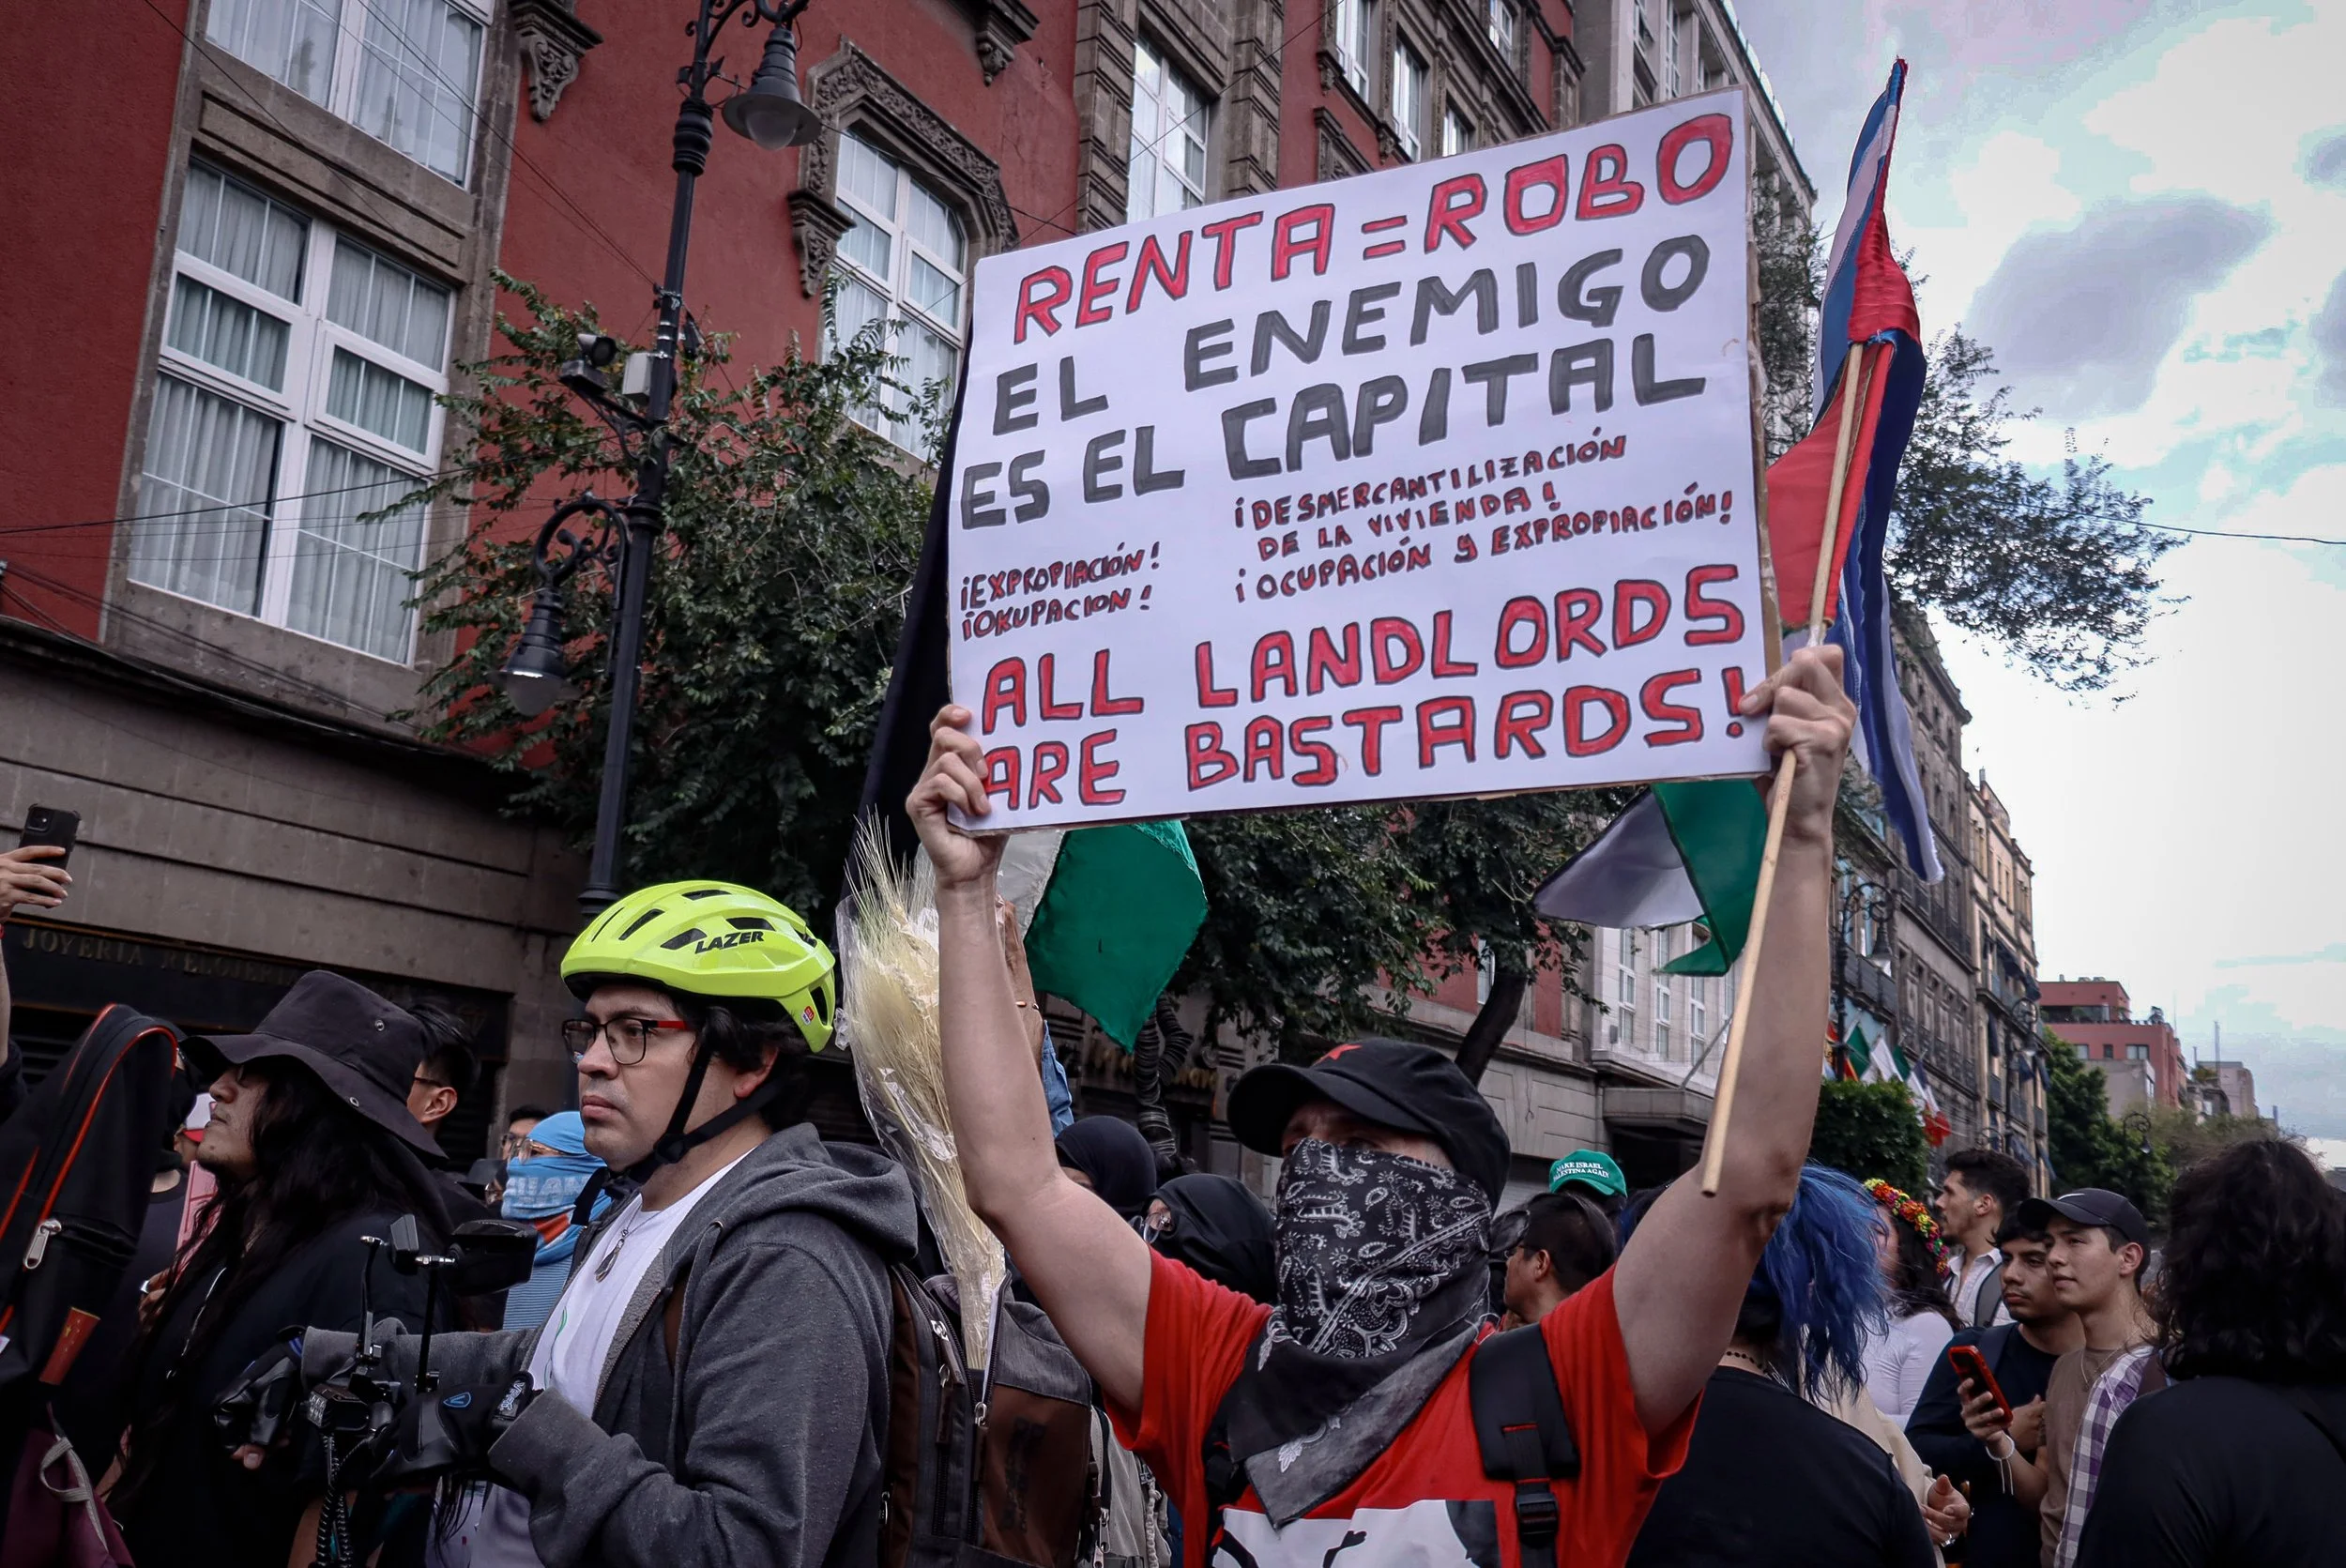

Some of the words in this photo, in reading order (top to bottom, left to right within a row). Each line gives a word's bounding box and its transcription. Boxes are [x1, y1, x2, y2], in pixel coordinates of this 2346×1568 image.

[993, 356, 1109, 435] EL
[1184, 235, 1710, 391] ENEMIGO
[961, 449, 1050, 529] ES
[1083, 425, 1185, 504] EL
[1222, 333, 1706, 480] CAPITAL
[1235, 427, 1627, 530] ¡DESMERCANTILIZACIÓN
[1257, 531, 1300, 561] DE
[1318, 525, 1352, 548] LA
[1491, 481, 1733, 556] EXPROPIACIÓN!
[960, 541, 1161, 611] ¡EXPROPIACIÓN!
[982, 648, 1144, 736] ALL
[1195, 564, 1744, 708] LANDLORDS
[982, 729, 1127, 811] ARE
[1185, 666, 1744, 792] BASTARDS!
[22, 927, 144, 966] JOYERIA
[694, 931, 765, 954] LAZER
[1556, 1162, 1576, 1174] MAKE
[1576, 1162, 1603, 1170] ISRAEL
[1587, 1168, 1609, 1179] AGAIN
